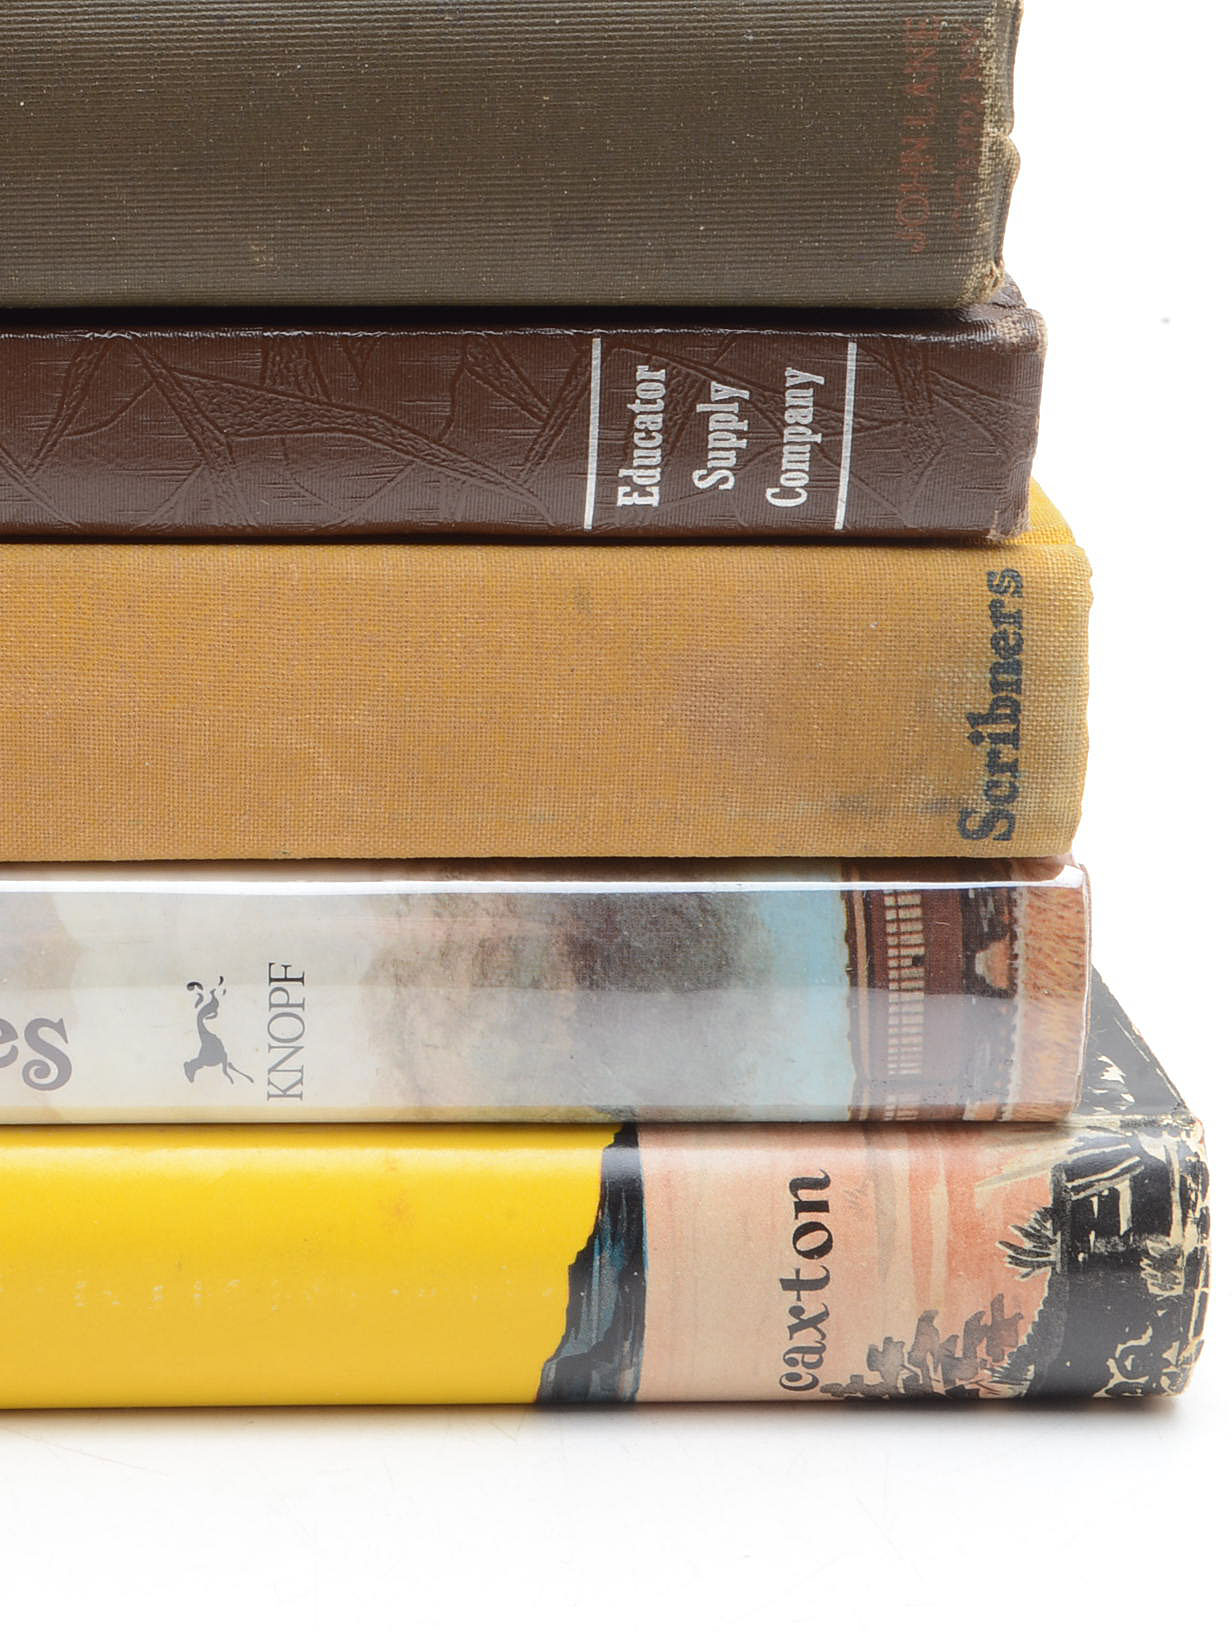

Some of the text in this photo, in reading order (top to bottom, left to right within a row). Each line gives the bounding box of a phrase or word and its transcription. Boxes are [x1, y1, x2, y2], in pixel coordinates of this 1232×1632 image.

[895, 15, 940, 253] JOHN LANE
[616, 365, 666, 507] Educator
[692, 381, 750, 490] Supply
[765, 367, 825, 508] Company
[956, 566, 1025, 842] Scribners
[266, 961, 306, 1101] KNOPF
[778, 1168, 833, 1393] caxton
